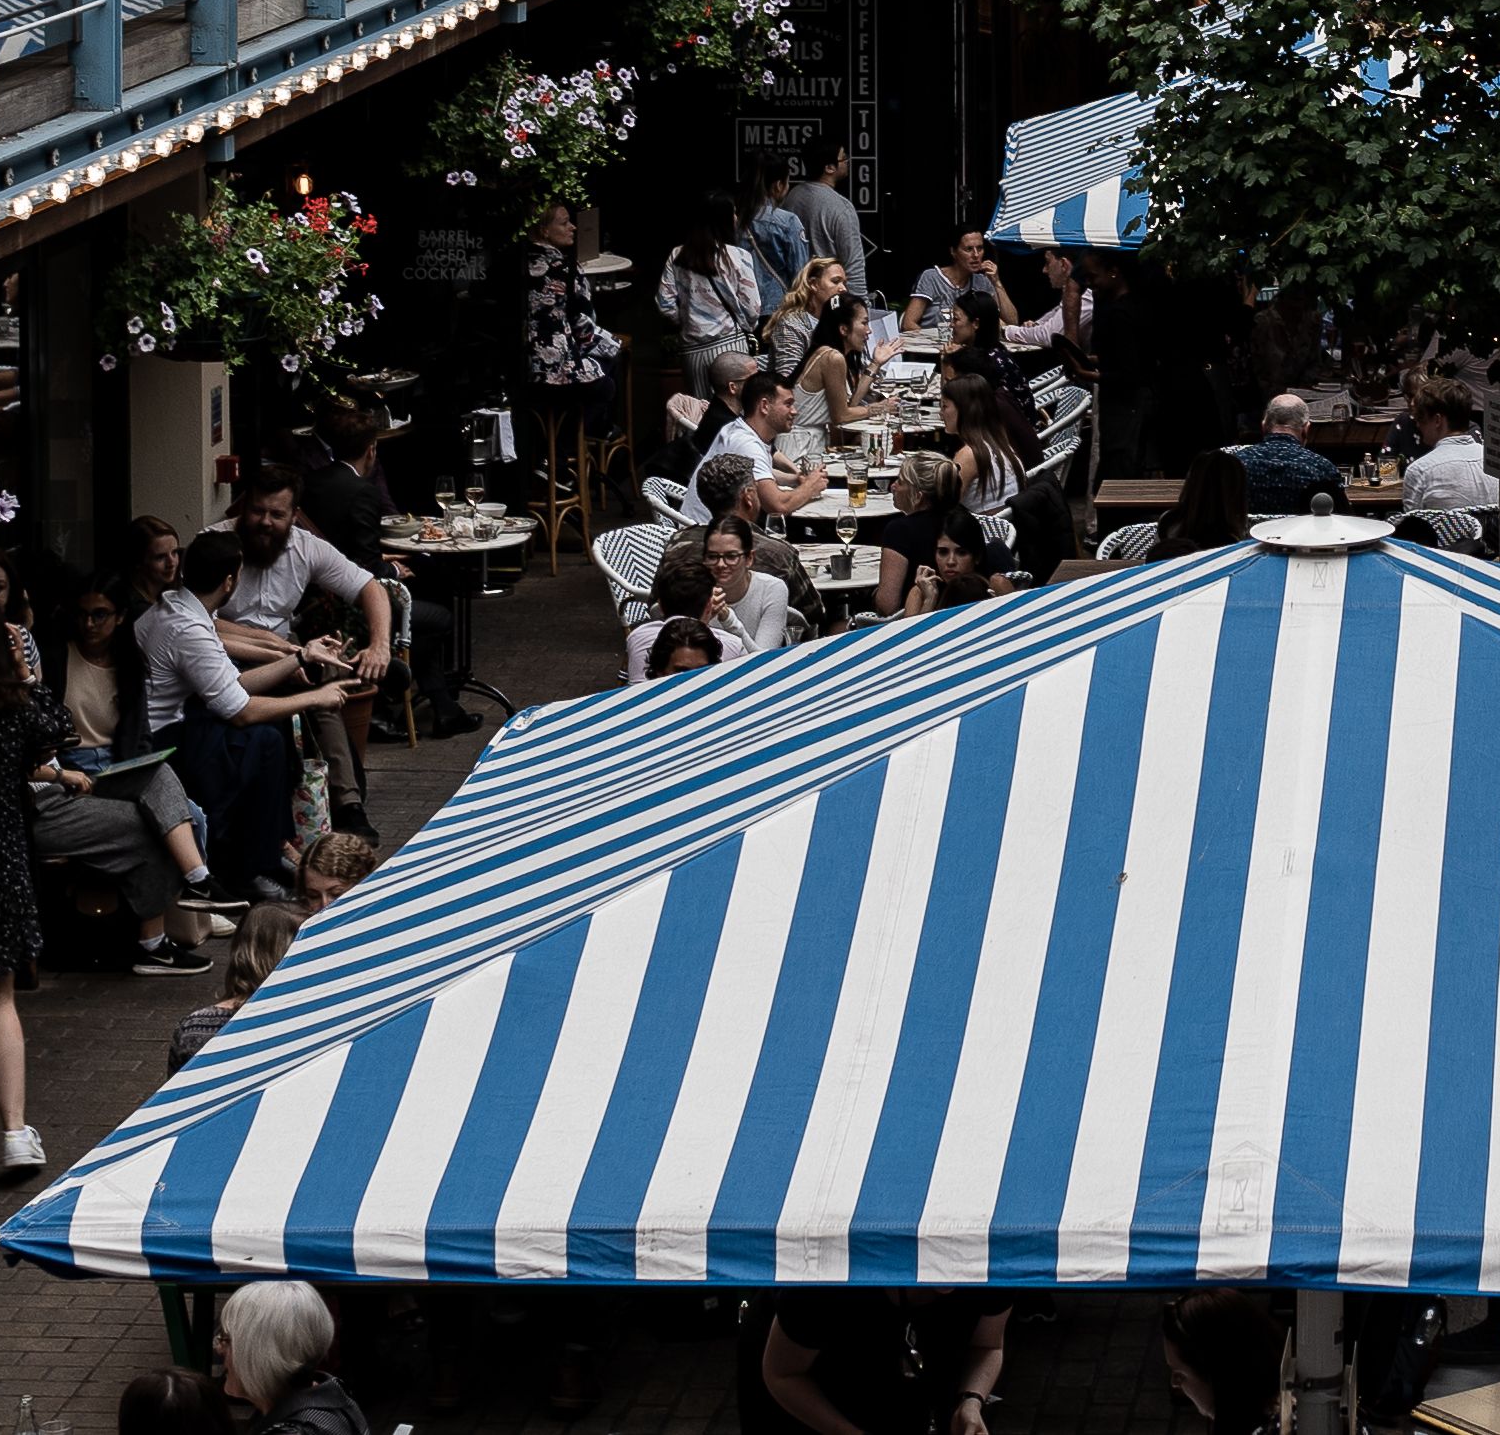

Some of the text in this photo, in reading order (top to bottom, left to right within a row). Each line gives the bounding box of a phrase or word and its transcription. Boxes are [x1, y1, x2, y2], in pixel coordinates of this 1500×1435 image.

[760, 76, 843, 101] QUALITY
[744, 124, 813, 146] MEATS
[857, 109, 870, 152] TO
[858, 163, 870, 207] GO
[401, 266, 488, 281] COCKTAILS
